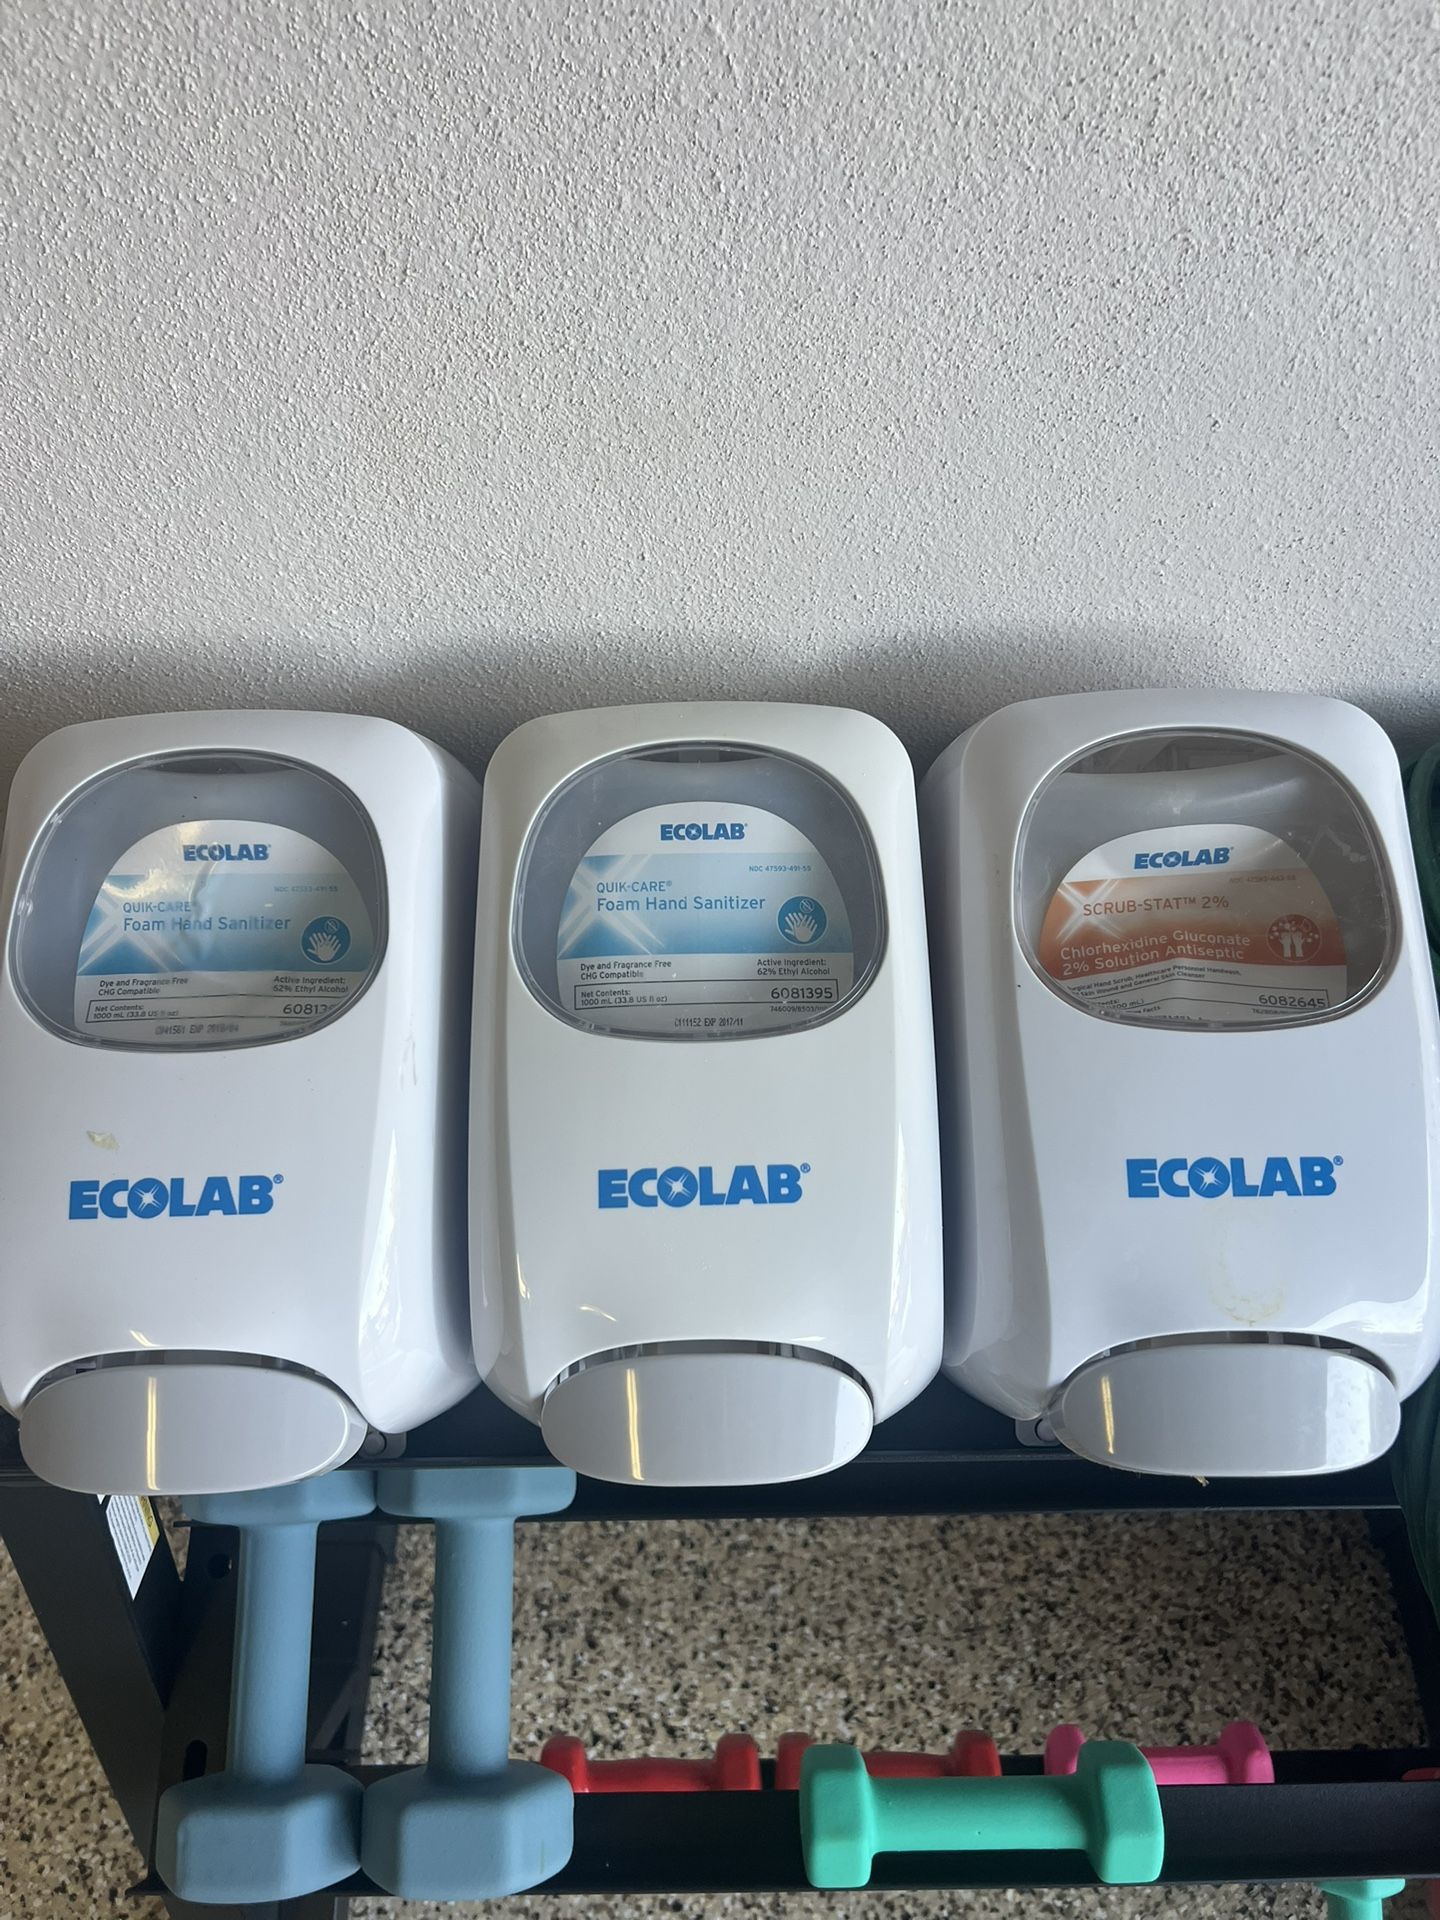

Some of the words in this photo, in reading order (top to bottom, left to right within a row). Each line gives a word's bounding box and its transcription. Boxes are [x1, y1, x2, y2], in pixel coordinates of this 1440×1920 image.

[597, 897, 640, 911] Foam
[646, 896, 688, 910] Hand
[693, 895, 765, 910] Sanitizer
[1201, 896, 1229, 909] 2%
[124, 918, 165, 931] Foam
[172, 916, 212, 930] Hand
[218, 916, 291, 930] Sanitizer
[1060, 932, 1168, 960] Chlorhexidine
[1172, 930, 1250, 946] Gluconate
[757, 959, 782, 967] Active
[784, 959, 827, 968] Ingredient:
[1062, 961, 1090, 976] 2%
[1094, 950, 1159, 970] Solution
[1165, 944, 1244, 960] Antiseptic
[580, 963, 595, 972] Dye
[614, 961, 652, 970] Fragrance
[654, 960, 672, 968] Free
[757, 967, 776, 976] 62%
[779, 967, 799, 976] Ethyl
[801, 967, 830, 975] Alcohol
[273, 975, 300, 984] Active
[302, 976, 346, 985] Ingredient:
[580, 973, 598, 981] CHG
[600, 970, 644, 980] Compatible
[100, 980, 113, 988] Dye
[132, 978, 170, 987] Fragrance
[171, 977, 188, 985] Free
[98, 988, 115, 997] CHG
[117, 987, 160, 997] Compatible
[295, 985, 316, 993] Ethyl
[318, 984, 348, 993] Alcohol
[595, 989, 631, 998] Contents:
[771, 987, 833, 999] 6081395
[581, 998, 599, 1006] 1000
[1259, 994, 1326, 1008] 6082645
[704, 1017, 716, 1027] EXP
